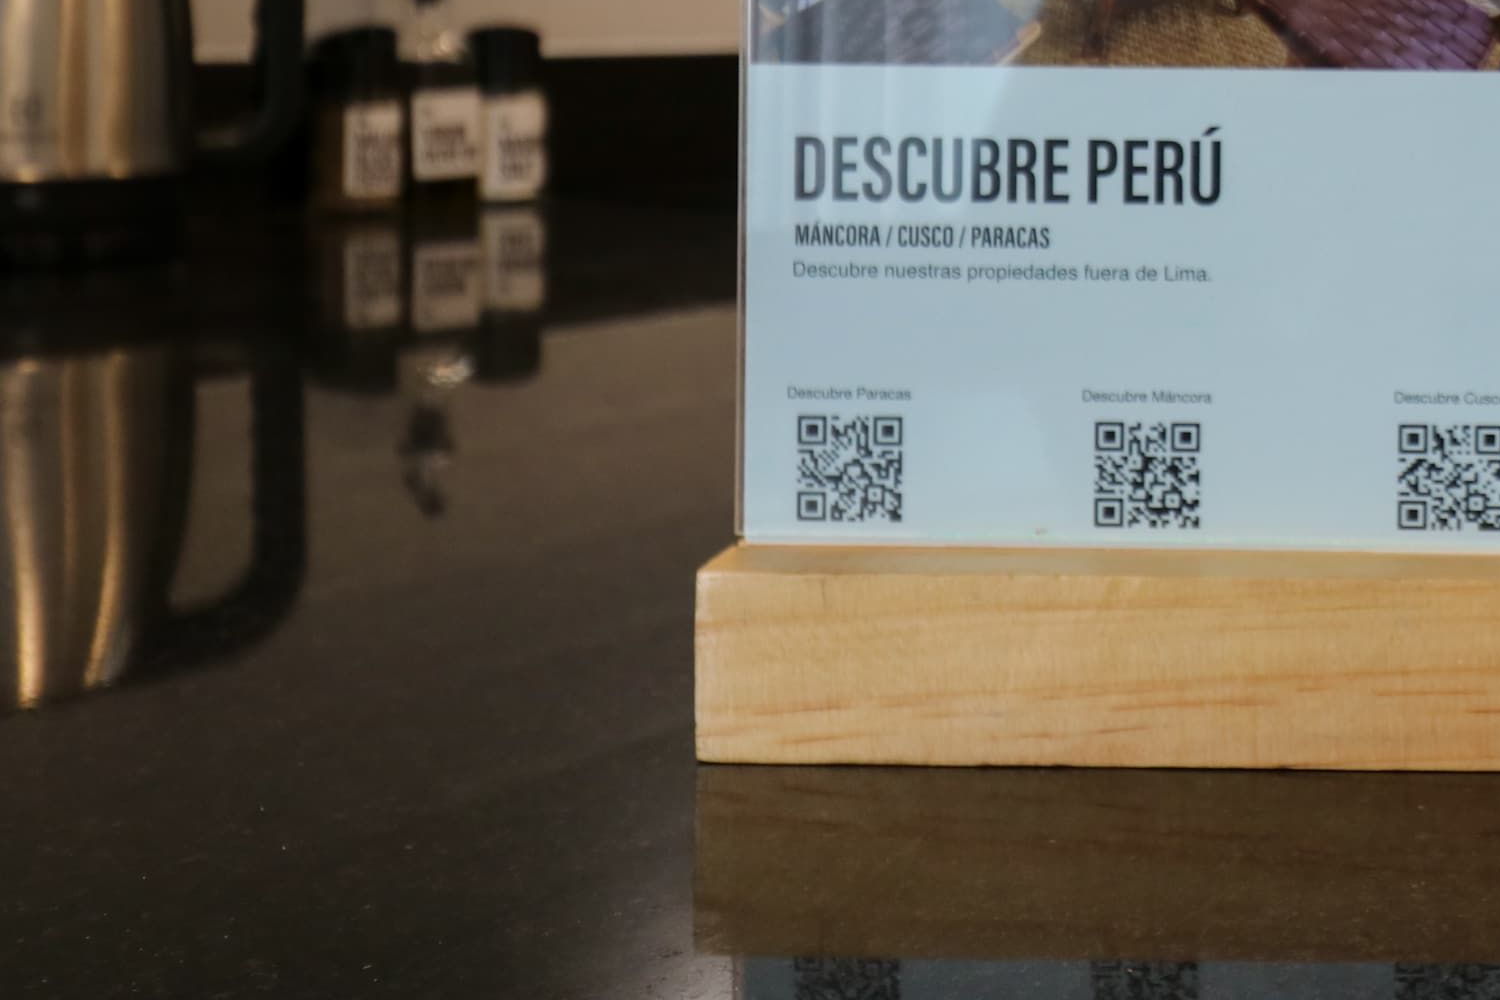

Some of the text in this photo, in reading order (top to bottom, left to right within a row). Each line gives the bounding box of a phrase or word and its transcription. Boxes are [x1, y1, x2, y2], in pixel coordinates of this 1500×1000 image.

[793, 126, 1222, 206] DESCUBRE PERÚ
[795, 221, 881, 248] MÁNCORA
[897, 225, 954, 249] CUSCO
[970, 226, 1051, 250] PARACAS
[792, 260, 1213, 284] Descubre nuestras propiedades fuera de Lima.
[786, 386, 852, 400] Descubre
[1082, 389, 1147, 403] Descubre
[1393, 390, 1460, 405] Descubre
